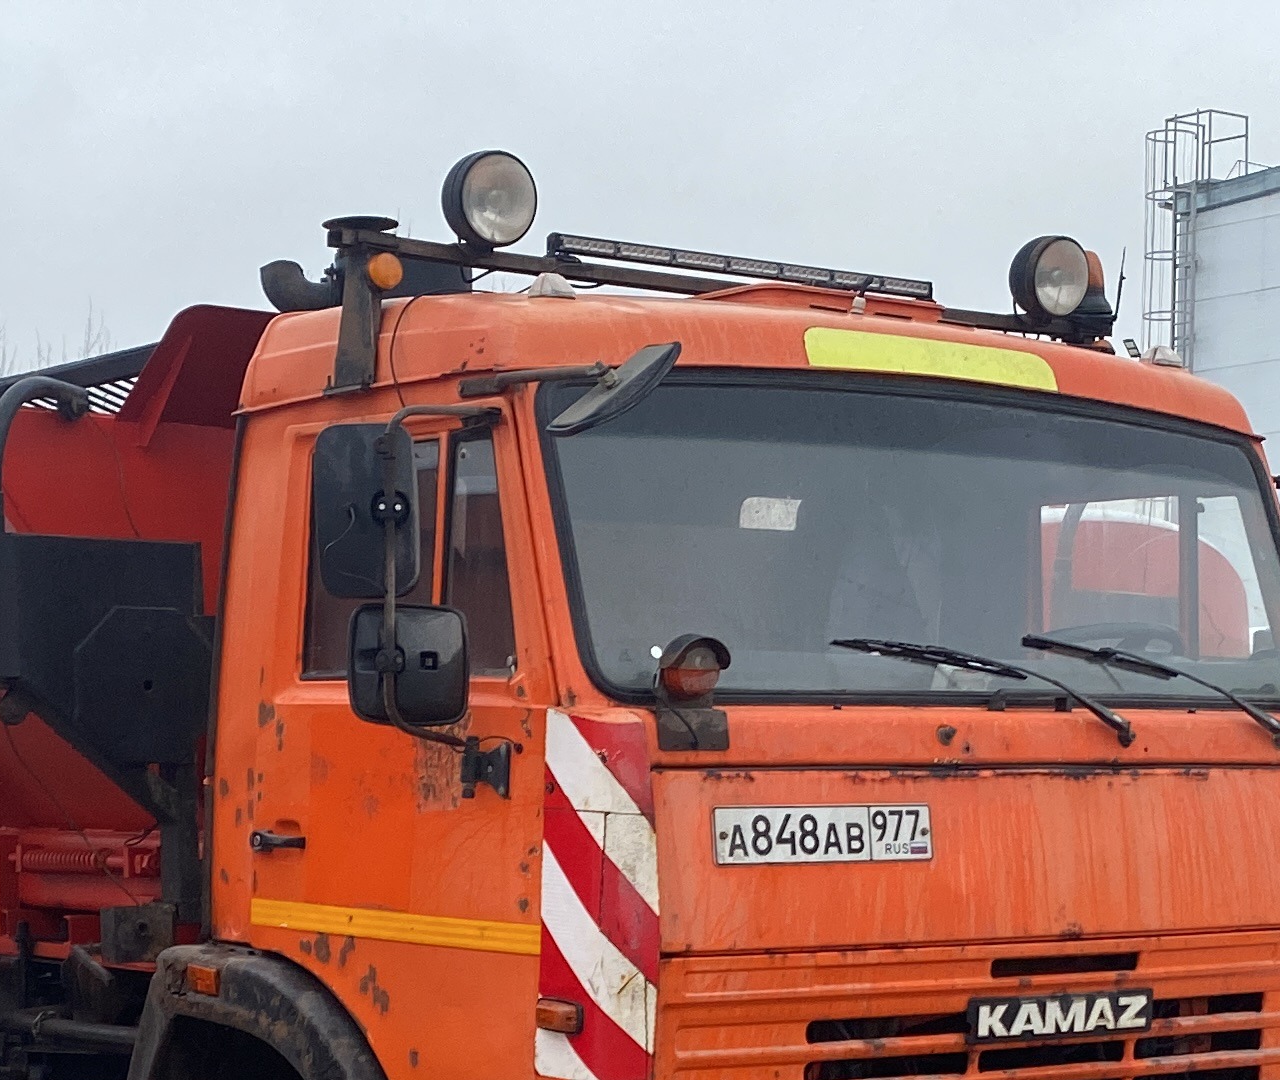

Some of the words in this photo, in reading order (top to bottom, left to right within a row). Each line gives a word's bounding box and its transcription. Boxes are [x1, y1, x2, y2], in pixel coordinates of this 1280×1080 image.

[728, 813, 865, 857] А848АВ
[872, 809, 920, 842] 977
[884, 843, 909, 855] RUS
[977, 995, 1148, 1038] KAMAZ
